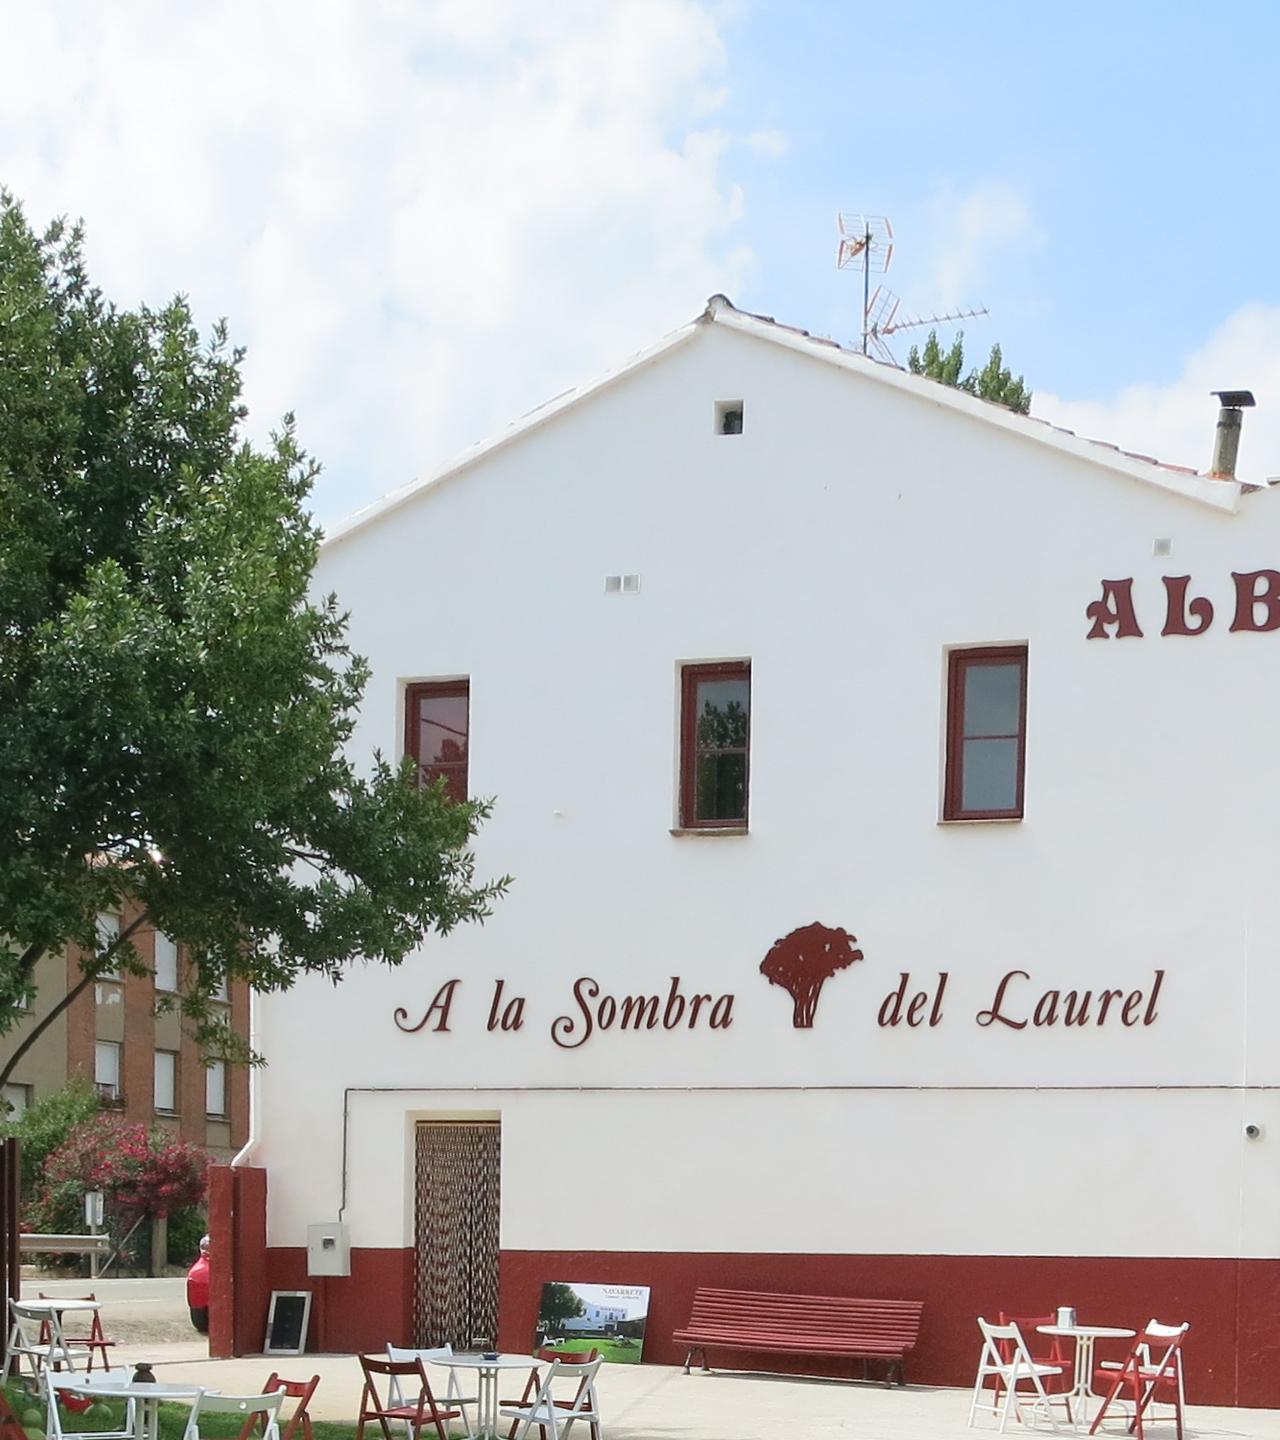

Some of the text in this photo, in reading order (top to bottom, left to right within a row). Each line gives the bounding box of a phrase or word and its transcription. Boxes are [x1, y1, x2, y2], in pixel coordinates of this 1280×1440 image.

[393, 969, 1165, 1049] A la Sombra del Laurel
